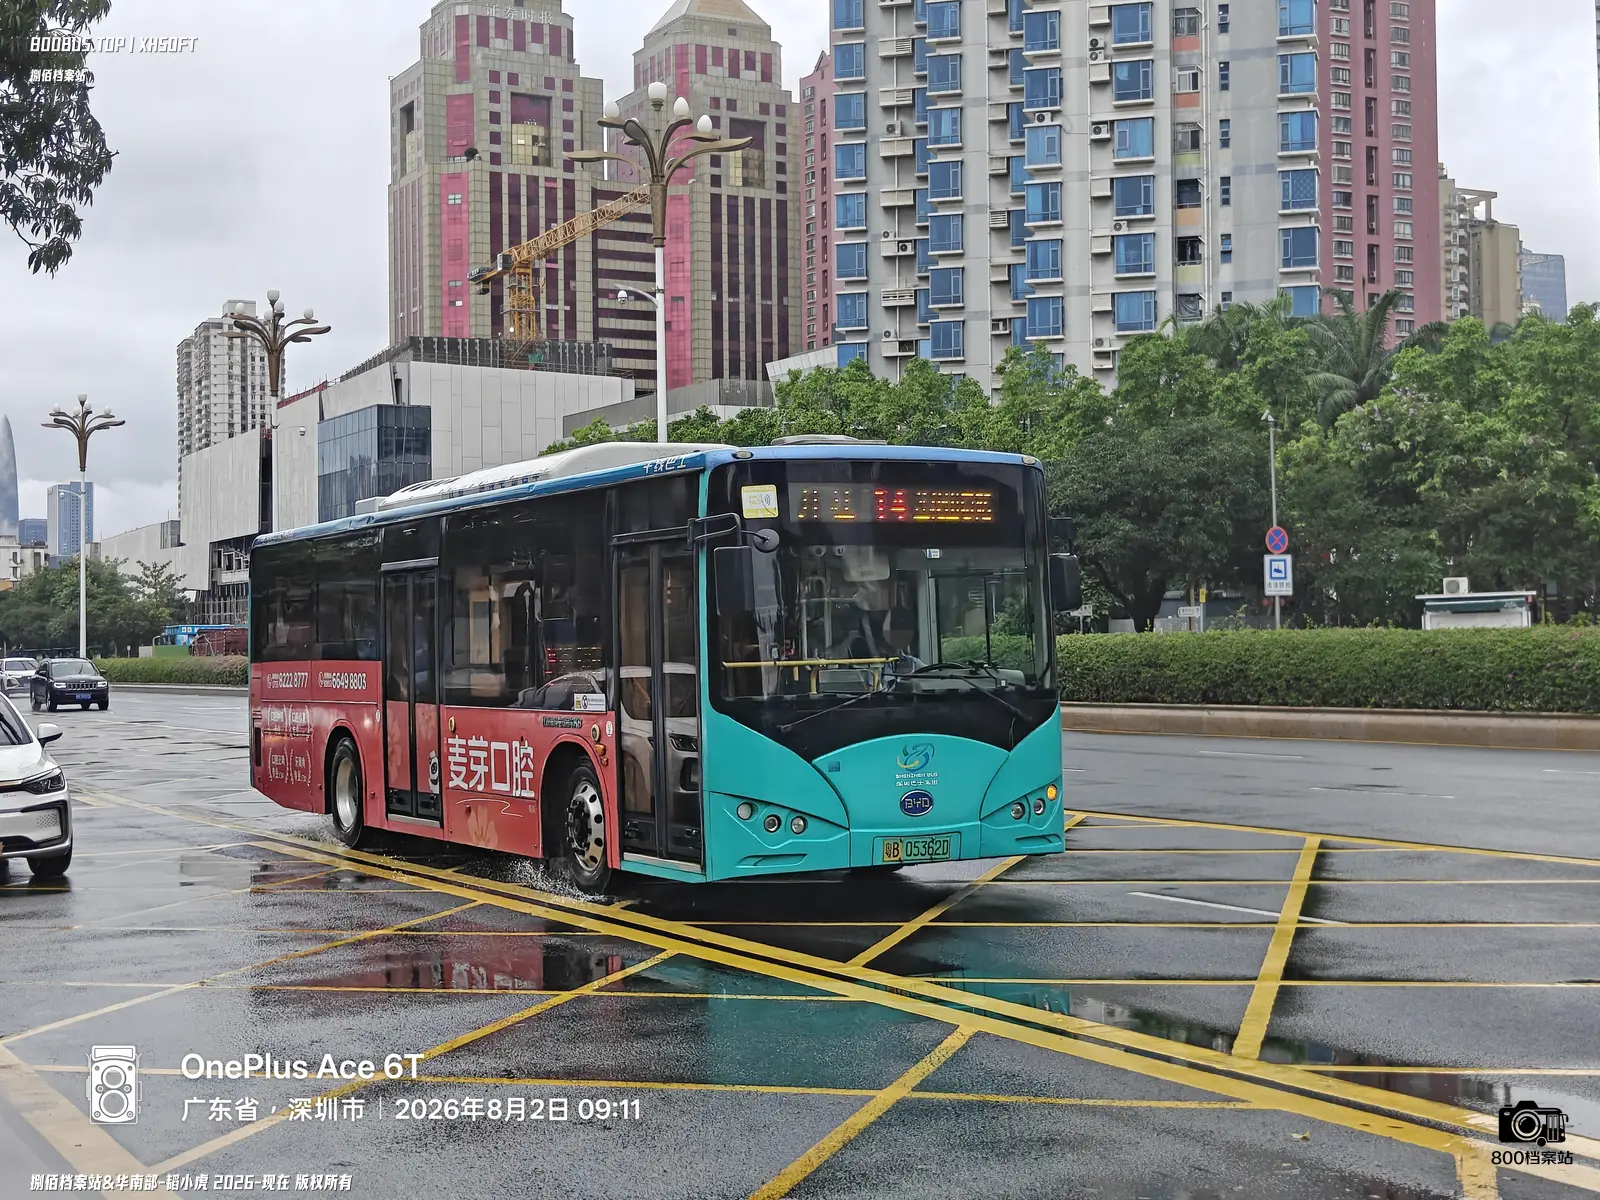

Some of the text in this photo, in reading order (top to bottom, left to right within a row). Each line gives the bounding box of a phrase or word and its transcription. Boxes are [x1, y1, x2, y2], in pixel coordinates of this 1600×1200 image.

[486, 4, 553, 24] 证券时报
[293, 672, 308, 688] 8777
[332, 672, 349, 689] 6649
[349, 673, 367, 690] 8803
[447, 734, 535, 798] 麦芽口腔
[904, 798, 930, 809] BYD
